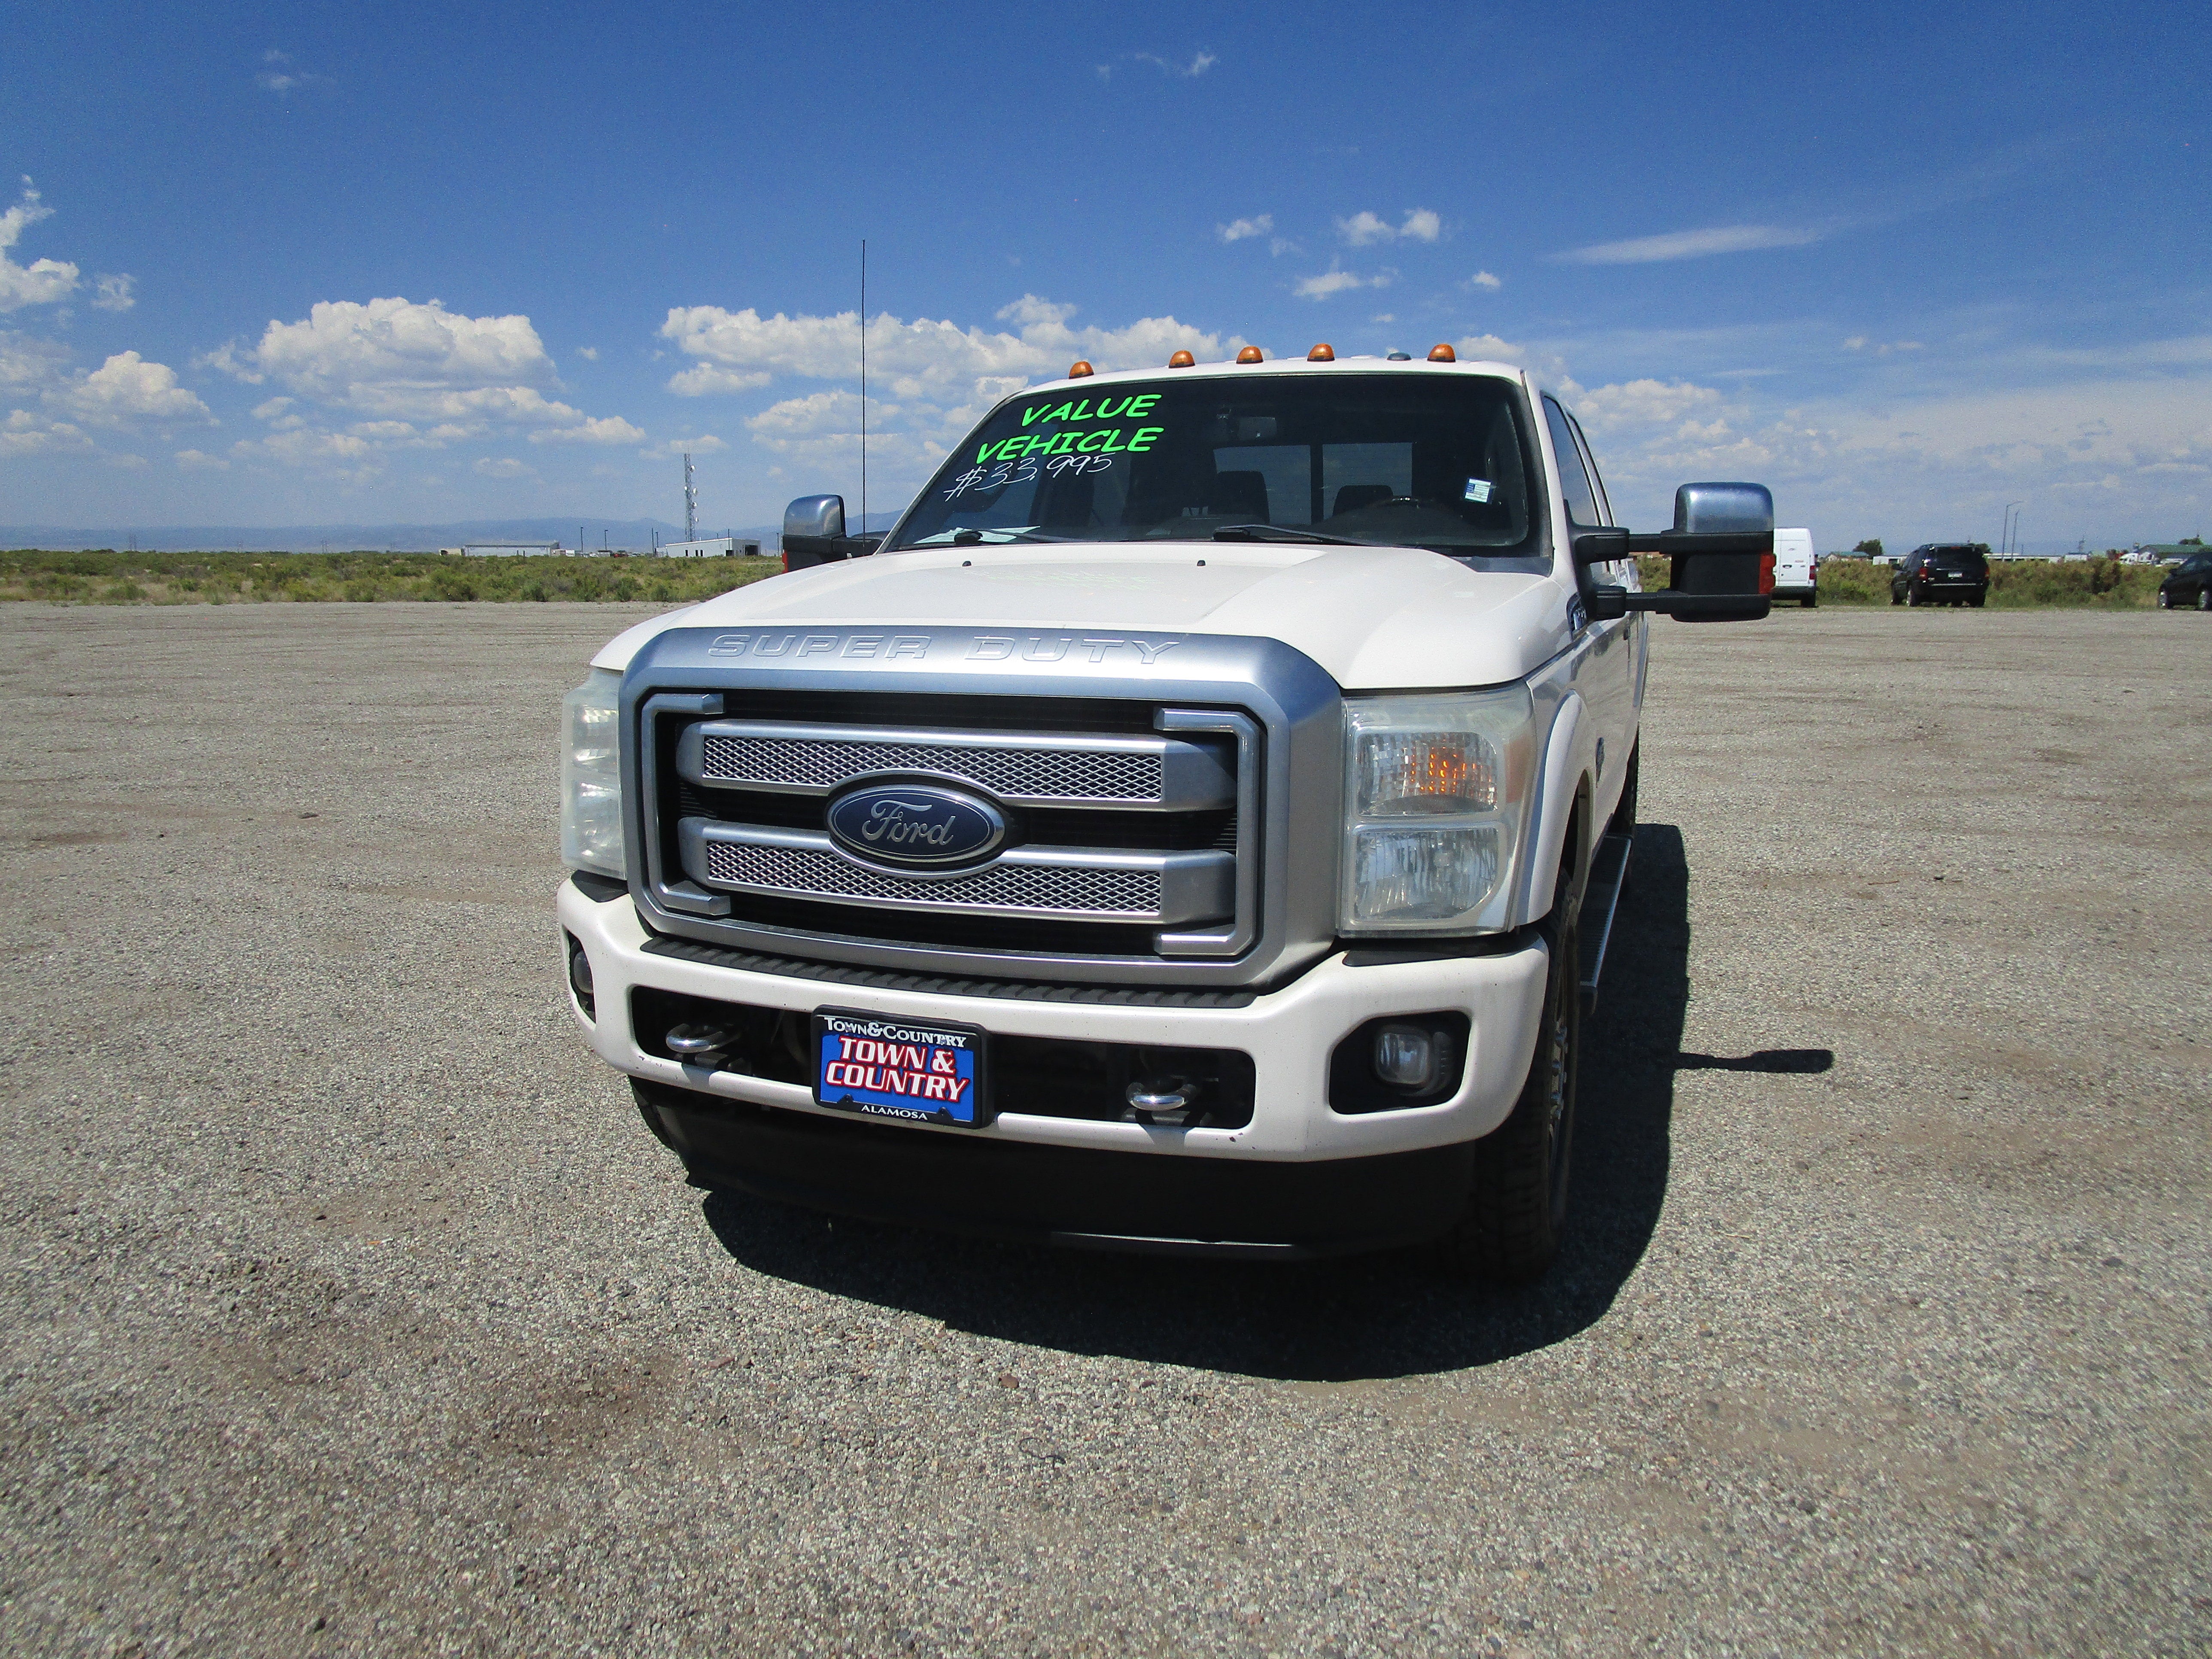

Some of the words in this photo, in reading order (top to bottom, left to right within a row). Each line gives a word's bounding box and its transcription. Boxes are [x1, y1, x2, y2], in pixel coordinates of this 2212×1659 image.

[1021, 394, 1162, 427] VALUE
[975, 427, 1164, 465] VEHICLE
[708, 634, 932, 659] SUPER
[964, 636, 1180, 664] DUTY
[862, 799, 956, 846] Ford
[839, 1036, 928, 1071] TOWN
[930, 1048, 956, 1075] &
[825, 1060, 969, 1103] COUNTRY
[861, 1104, 928, 1121] ALAMOSA
